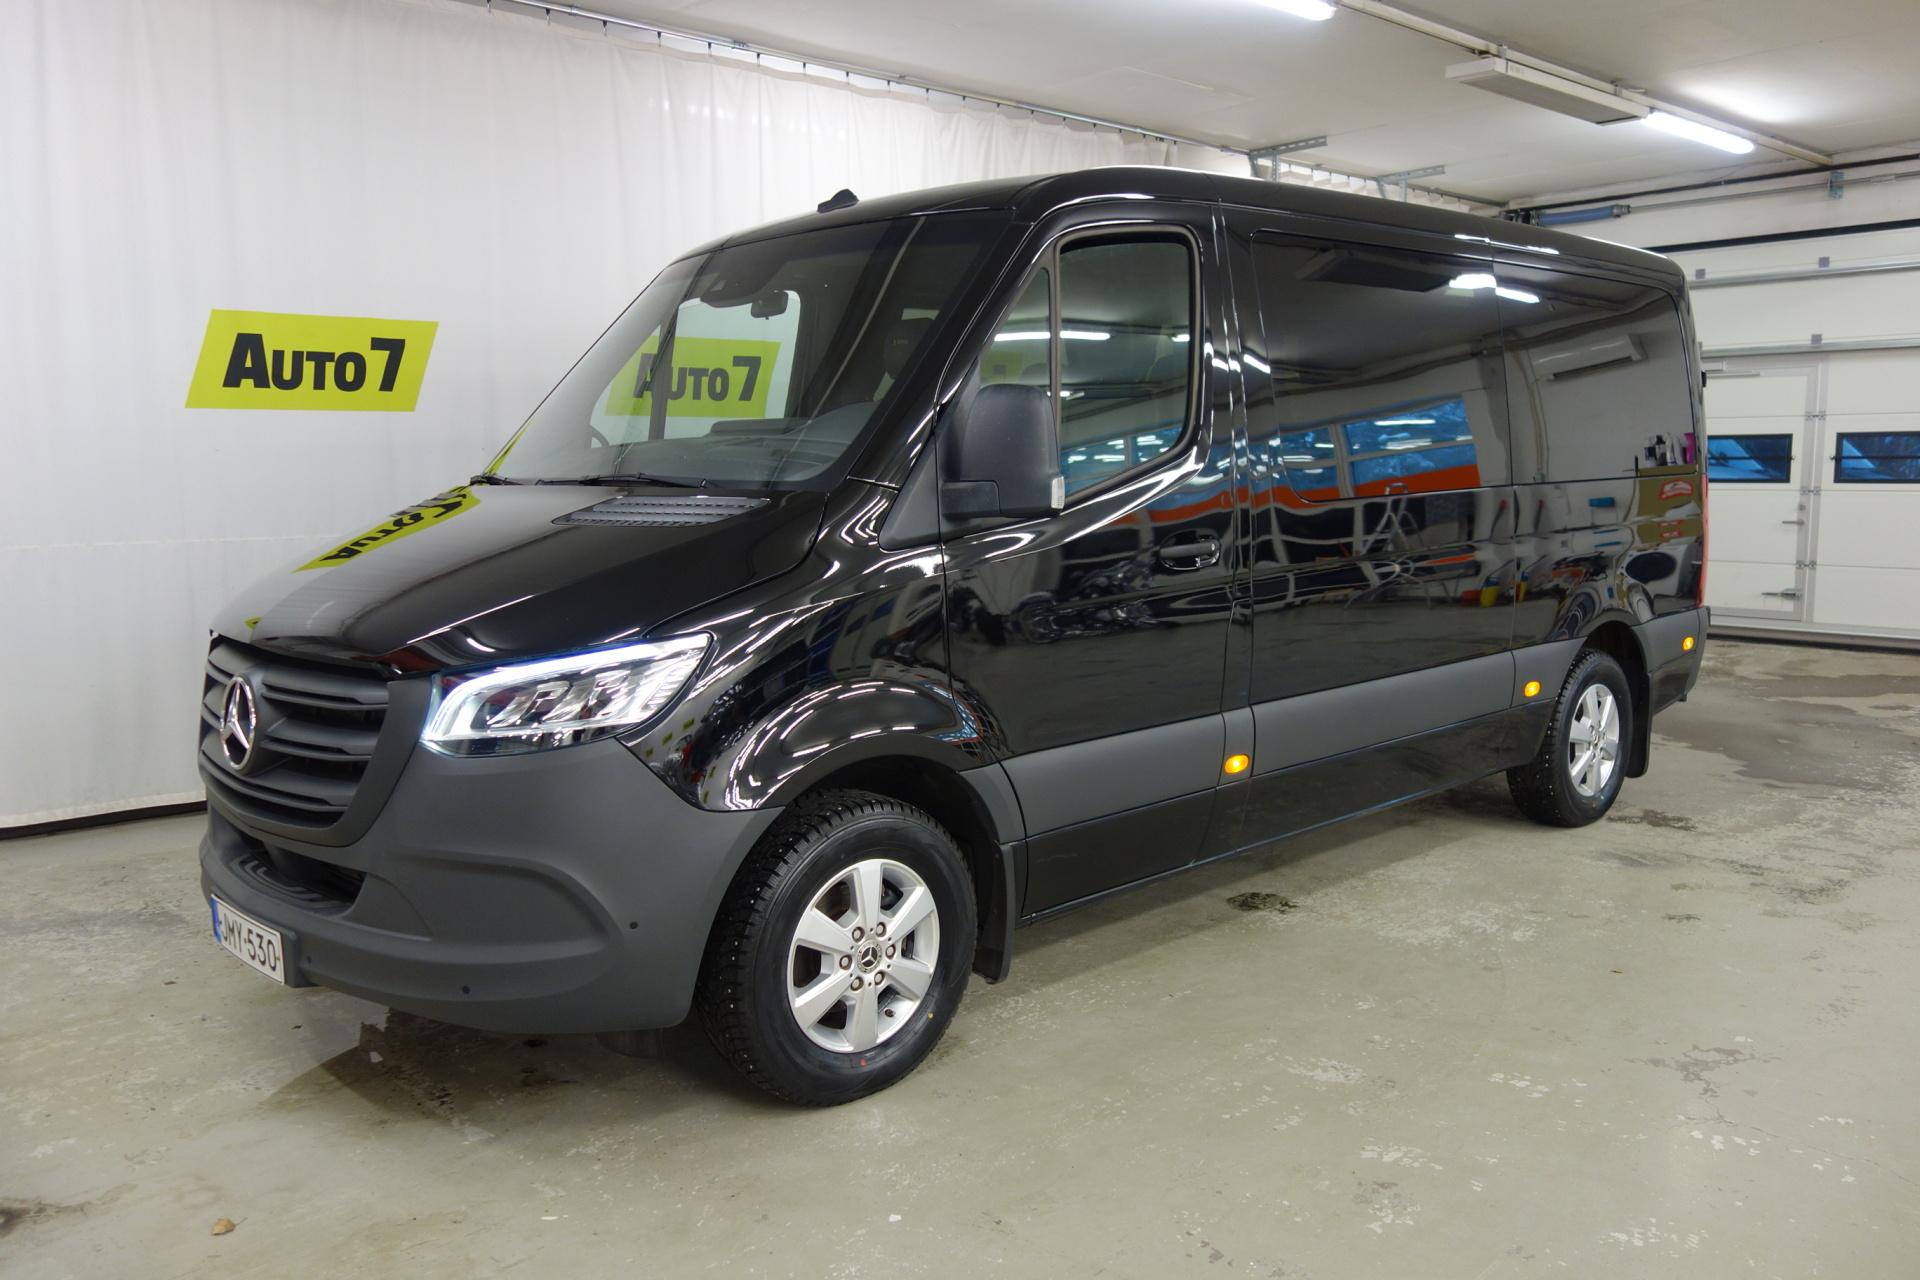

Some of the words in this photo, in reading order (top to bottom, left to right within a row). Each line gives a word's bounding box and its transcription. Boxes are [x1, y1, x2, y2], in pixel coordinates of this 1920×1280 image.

[222, 332, 367, 392] AUTO
[370, 336, 406, 392] 7
[732, 355, 762, 401] 7
[221, 912, 277, 972] JMY-530
